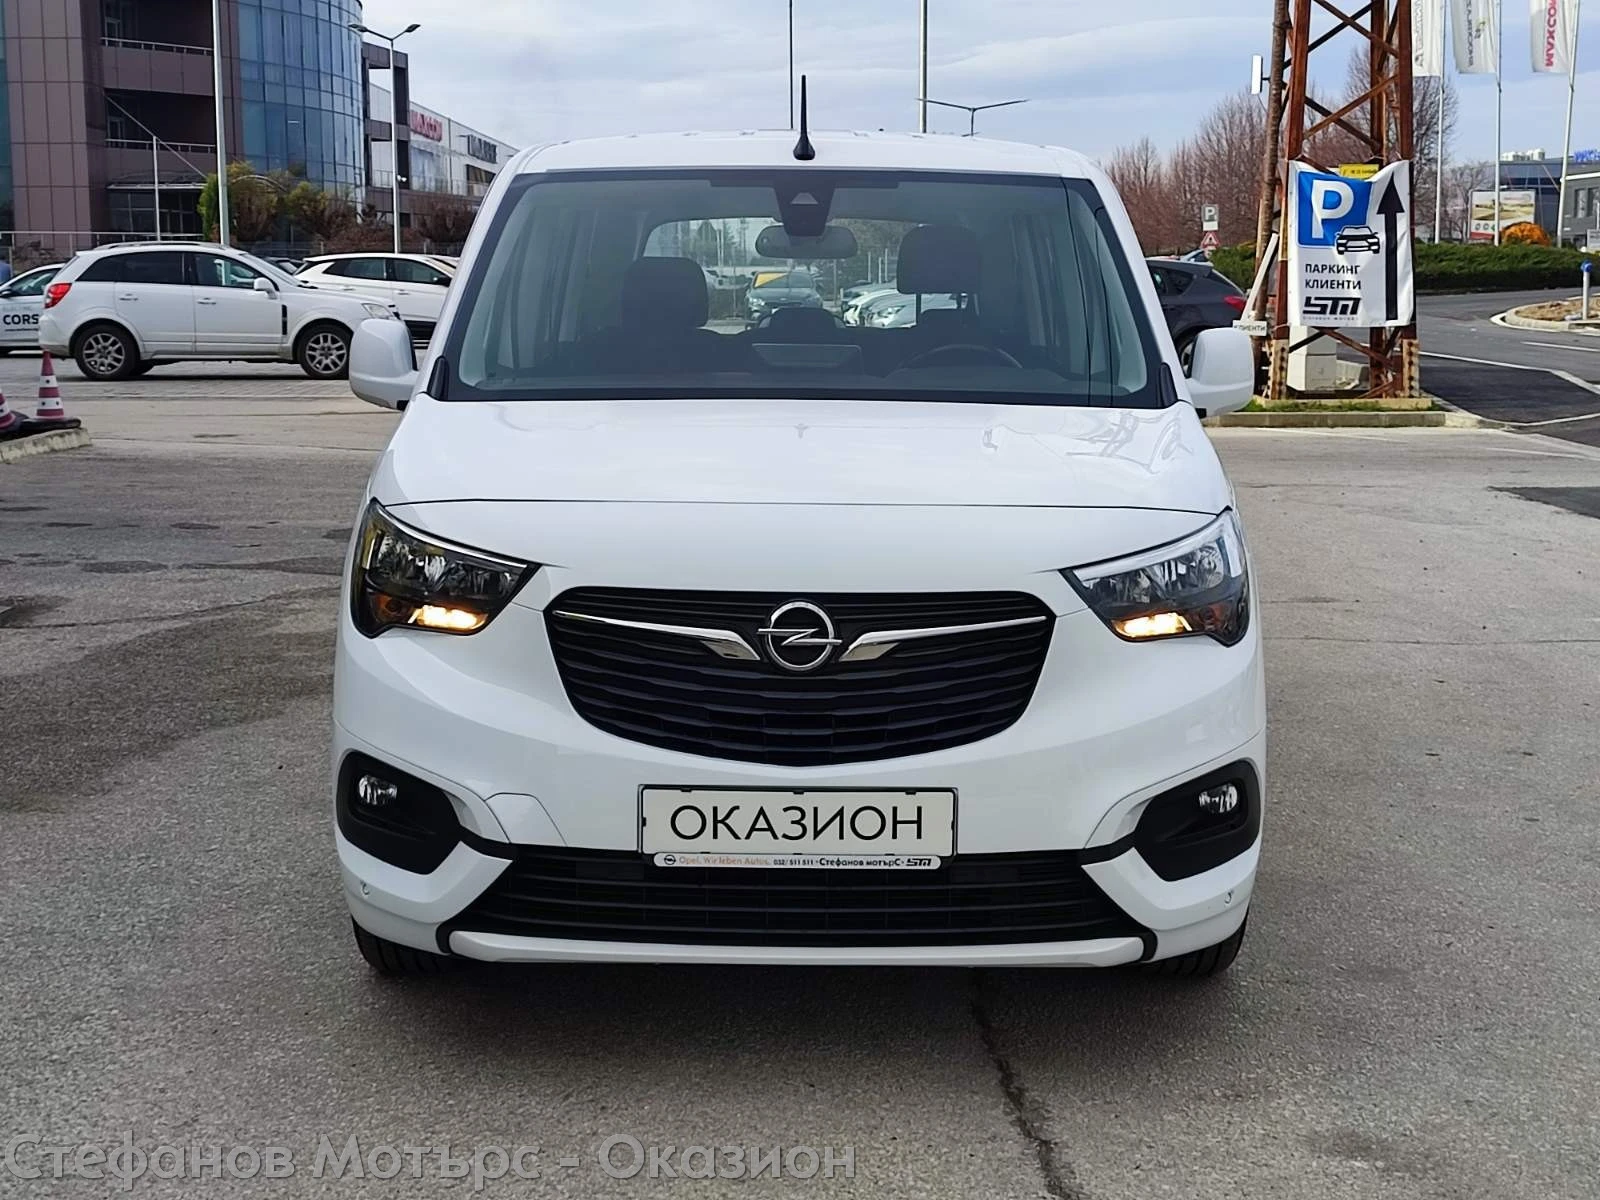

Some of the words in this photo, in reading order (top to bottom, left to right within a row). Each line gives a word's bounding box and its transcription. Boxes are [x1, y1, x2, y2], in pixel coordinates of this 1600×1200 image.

[1204, 206, 1215, 220] P
[1312, 179, 1355, 239] P
[1305, 263, 1361, 274] ПАРКИНГ
[1305, 279, 1362, 290] КЛИЕНТИ
[3, 314, 39, 325] CORS
[670, 805, 922, 840] ОКАЗИОН
